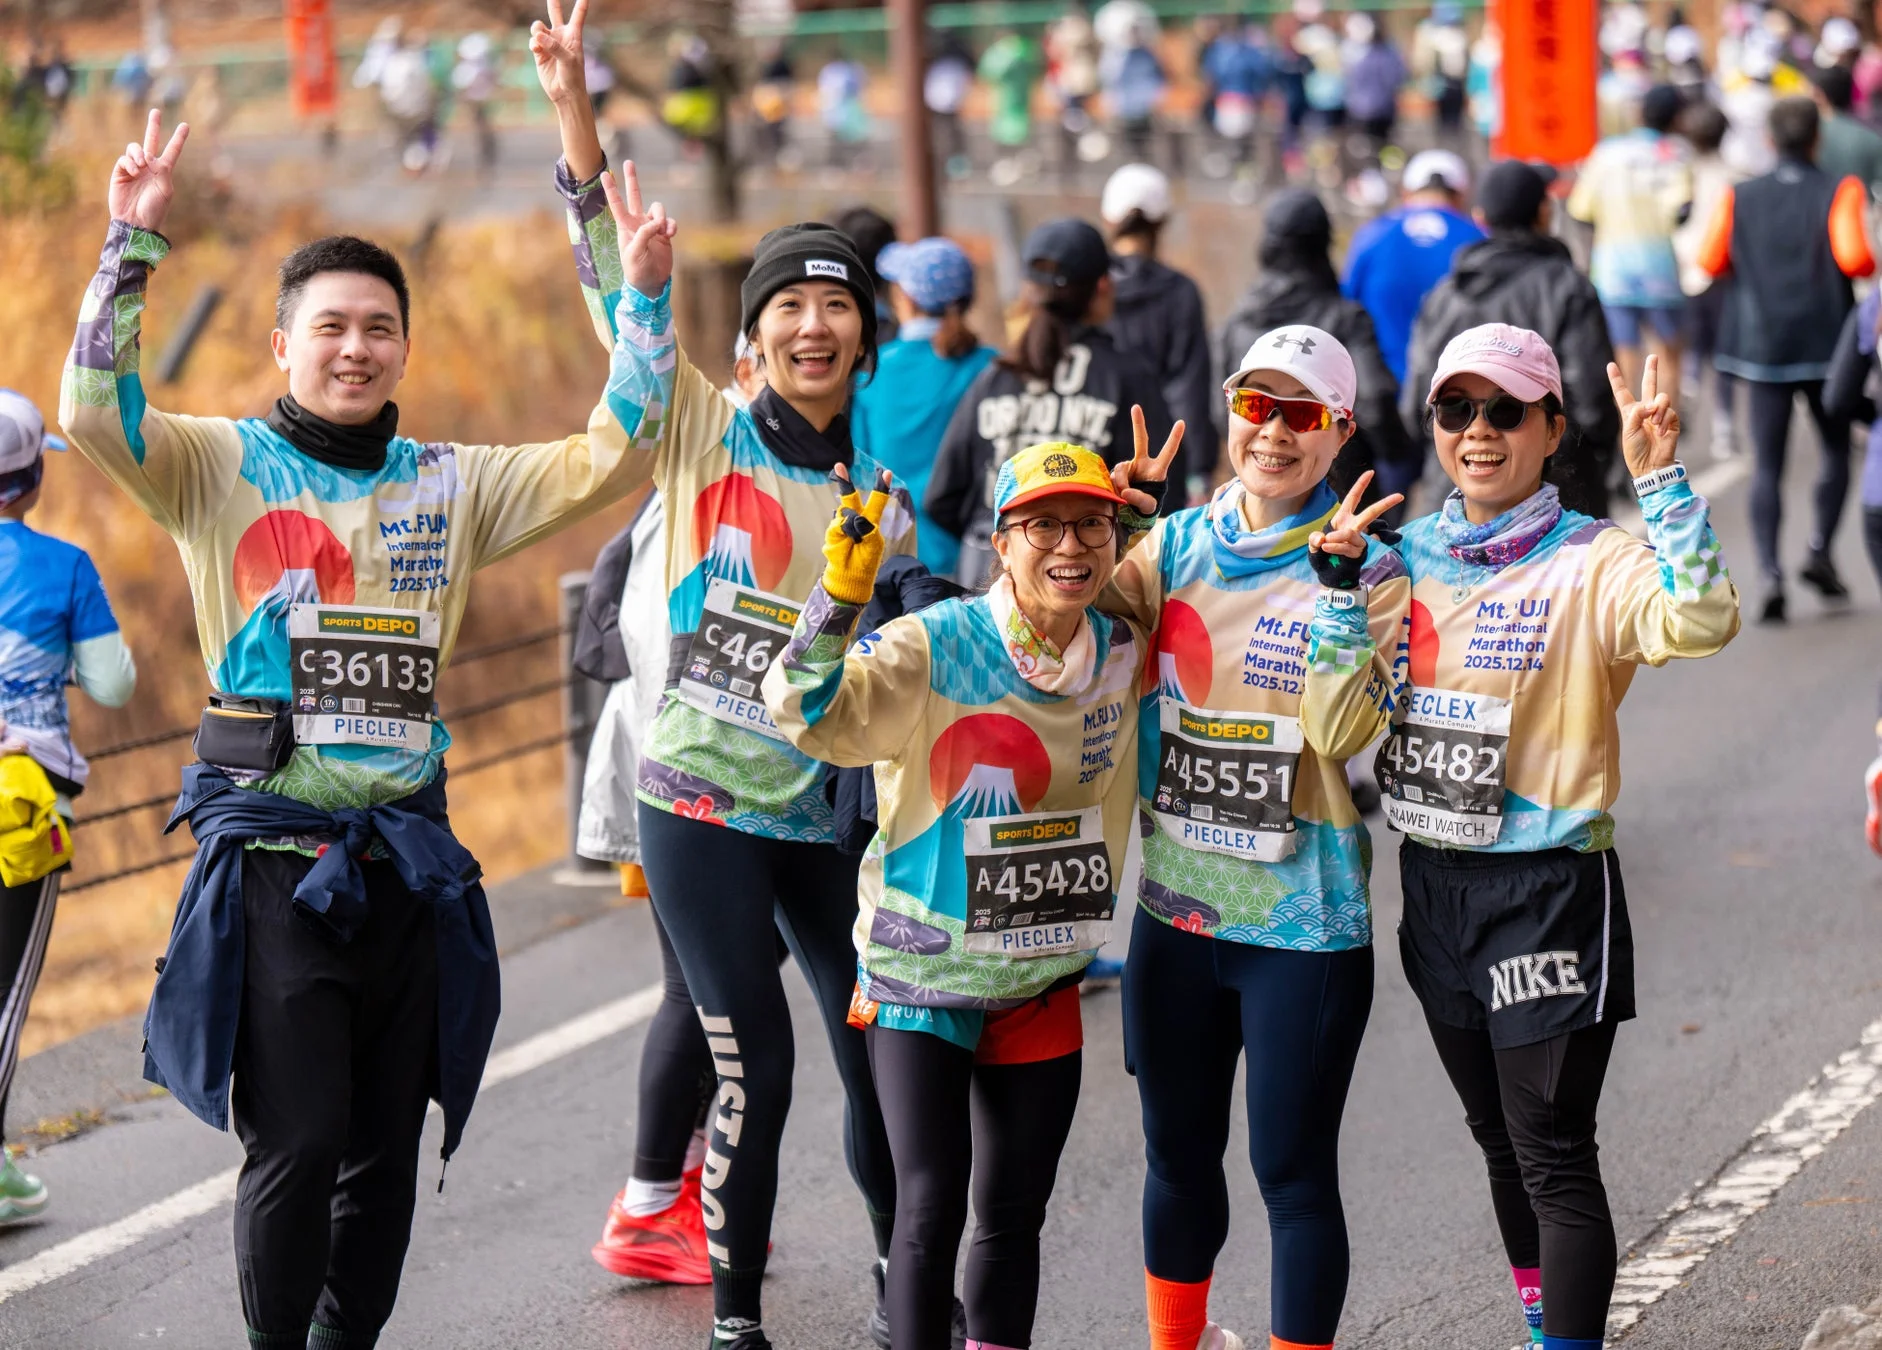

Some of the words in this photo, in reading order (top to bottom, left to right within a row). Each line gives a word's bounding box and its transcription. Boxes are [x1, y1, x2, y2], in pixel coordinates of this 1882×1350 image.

[811, 263, 843, 275] MoMA
[739, 600, 777, 617] SPORTS
[323, 617, 361, 627] SPORTS
[363, 617, 416, 634] DEPO
[1468, 637, 1545, 652] Marathon
[1463, 655, 1544, 671] 2025.12.14
[335, 718, 407, 738] PIECLEX
[1182, 718, 1206, 733] SPORTS
[1208, 722, 1269, 740] DEPO
[996, 829, 1032, 840] SPORTS
[1033, 821, 1076, 839] DEPO
[1184, 823, 1257, 851] PIECLEX
[1435, 817, 1485, 837] WATCH
[1002, 926, 1074, 949] PIECLEX
[1488, 951, 1587, 1012] NIKE
[697, 1005, 746, 1146] JUST
[701, 1146, 732, 1231] DO
